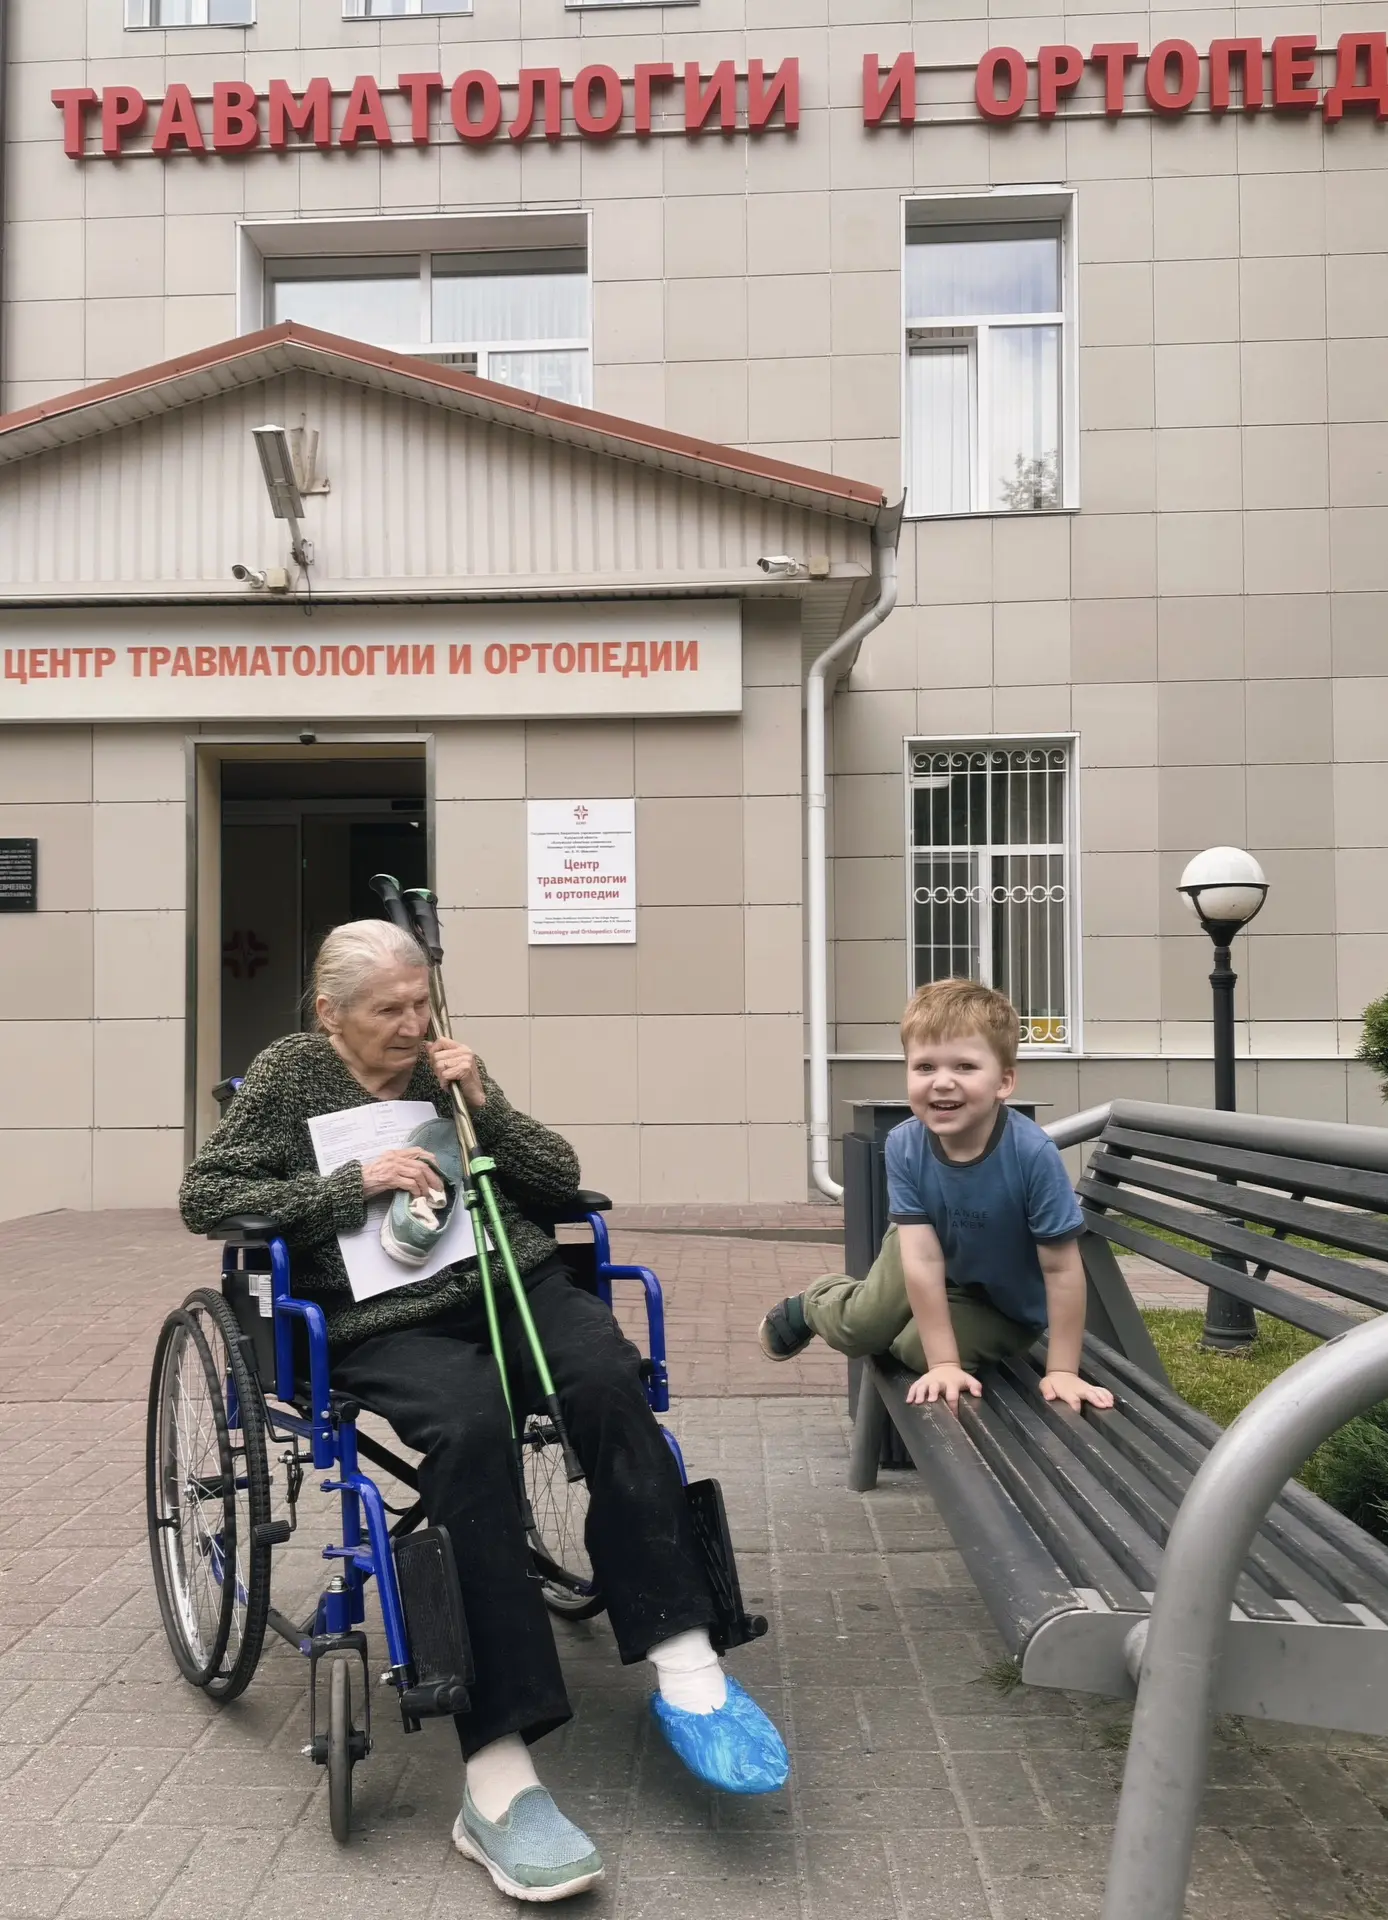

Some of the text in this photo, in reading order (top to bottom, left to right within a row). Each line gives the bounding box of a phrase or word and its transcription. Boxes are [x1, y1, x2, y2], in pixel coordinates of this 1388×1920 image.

[51, 31, 1388, 160] ТРАВМАТОЛОГИИ И ОРТОПЕД
[4, 640, 700, 685] ЦЕНТР ТРАВМАТОЛОГИИ И ОРТОПЕДИИ
[564, 859, 600, 872] Центр
[537, 875, 627, 887] травматологии
[544, 890, 620, 902] и ортопедии
